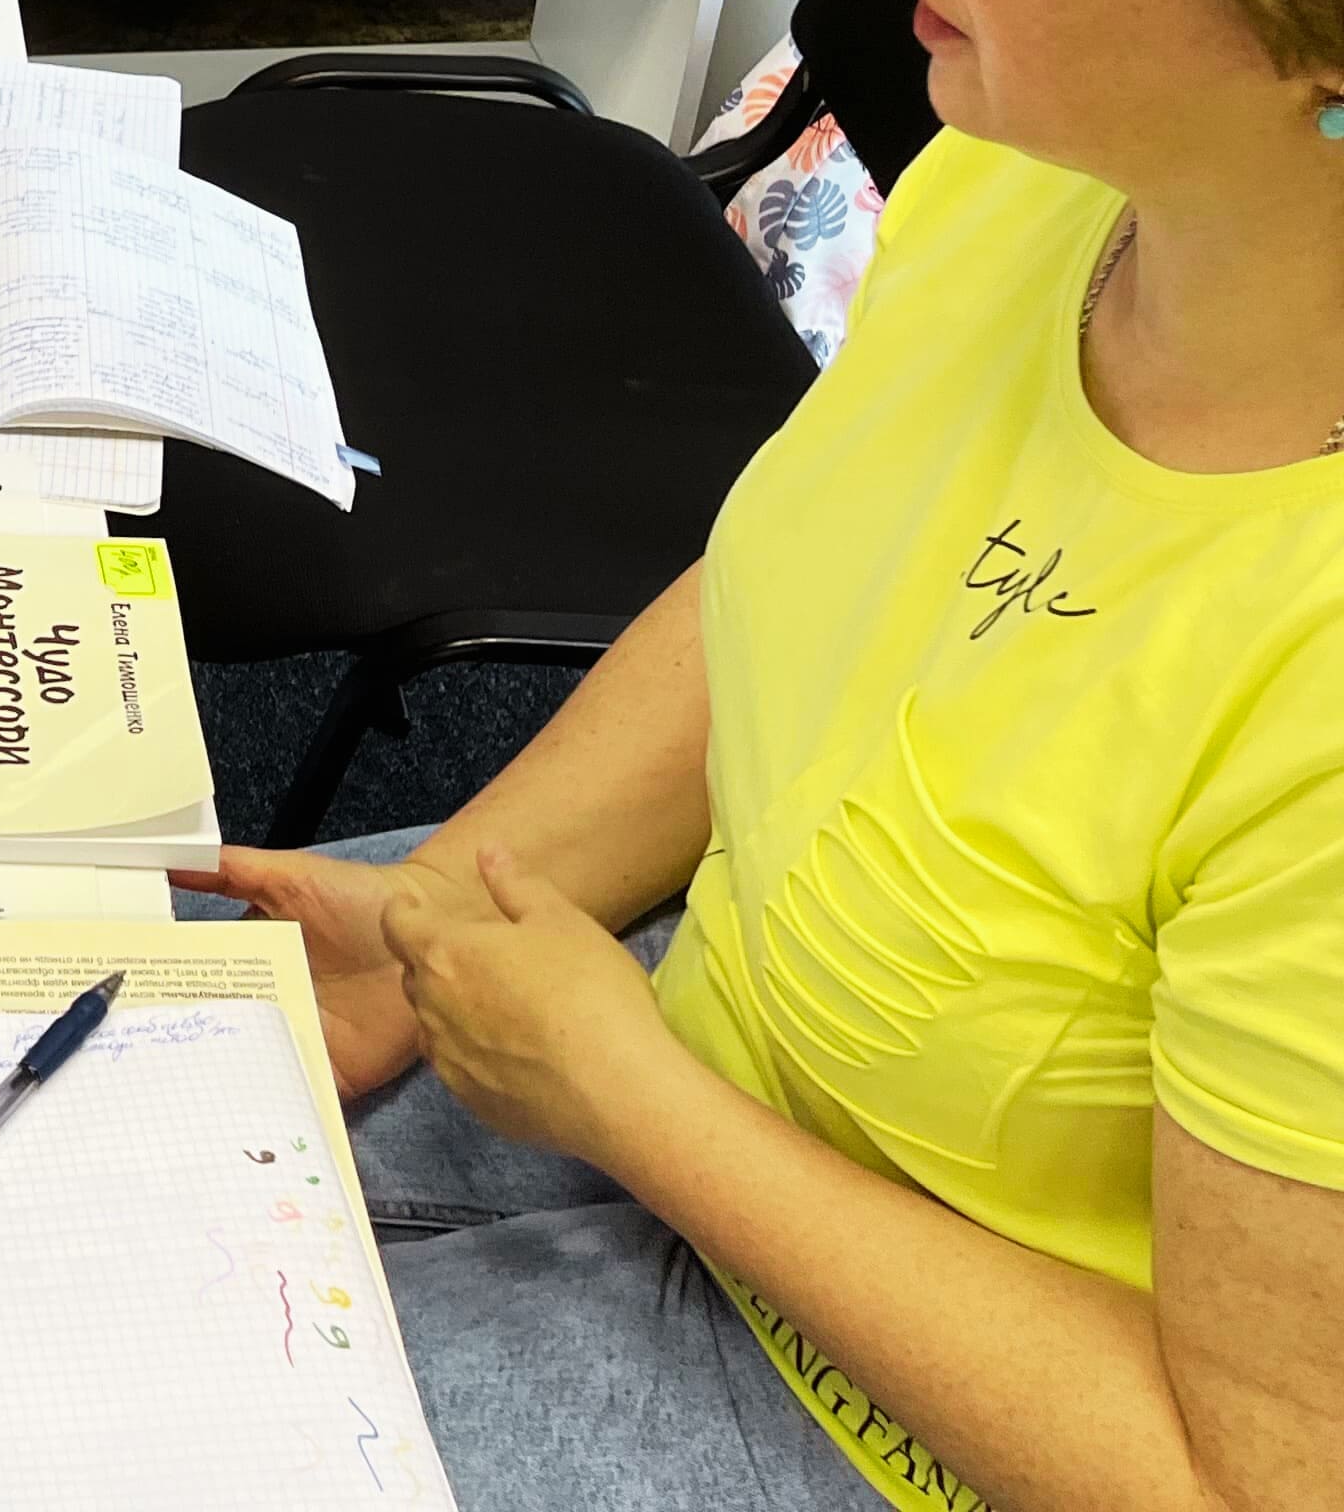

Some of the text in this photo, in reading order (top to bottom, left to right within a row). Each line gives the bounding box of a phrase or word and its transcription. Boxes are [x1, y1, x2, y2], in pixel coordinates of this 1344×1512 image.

[21, 624, 80, 704] Чудо
[111, 602, 144, 734] Елена Тимошенко
